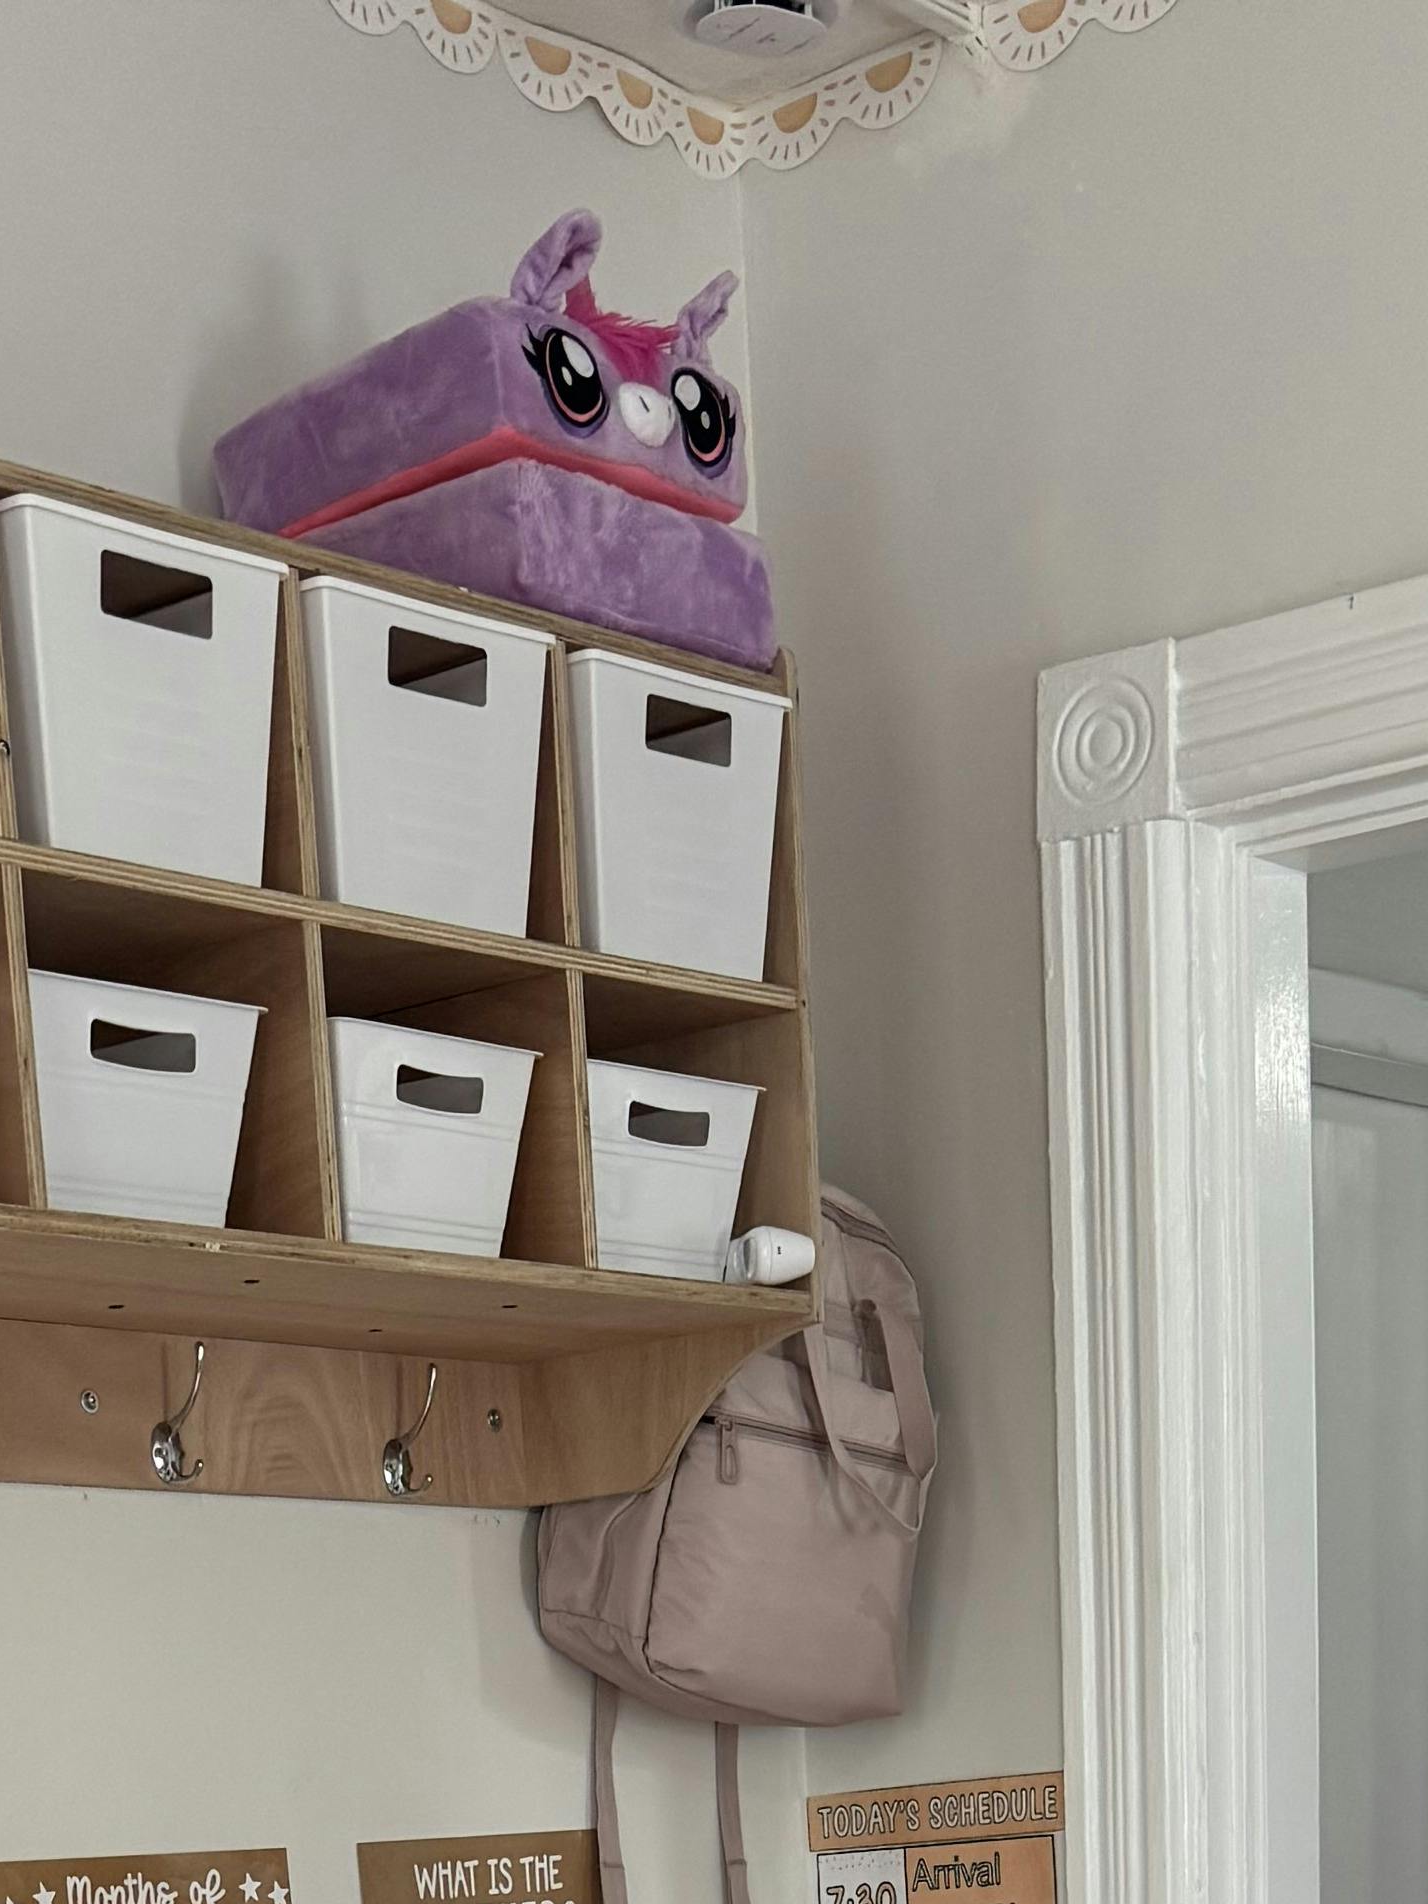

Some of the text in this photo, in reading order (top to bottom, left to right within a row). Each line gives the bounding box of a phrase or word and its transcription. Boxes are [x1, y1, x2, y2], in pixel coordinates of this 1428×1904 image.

[817, 1787, 1057, 1840] TODAY'S SCHEDULE
[414, 1854, 563, 1900] WHAT IS THE
[913, 1853, 1001, 1891] Arrival
